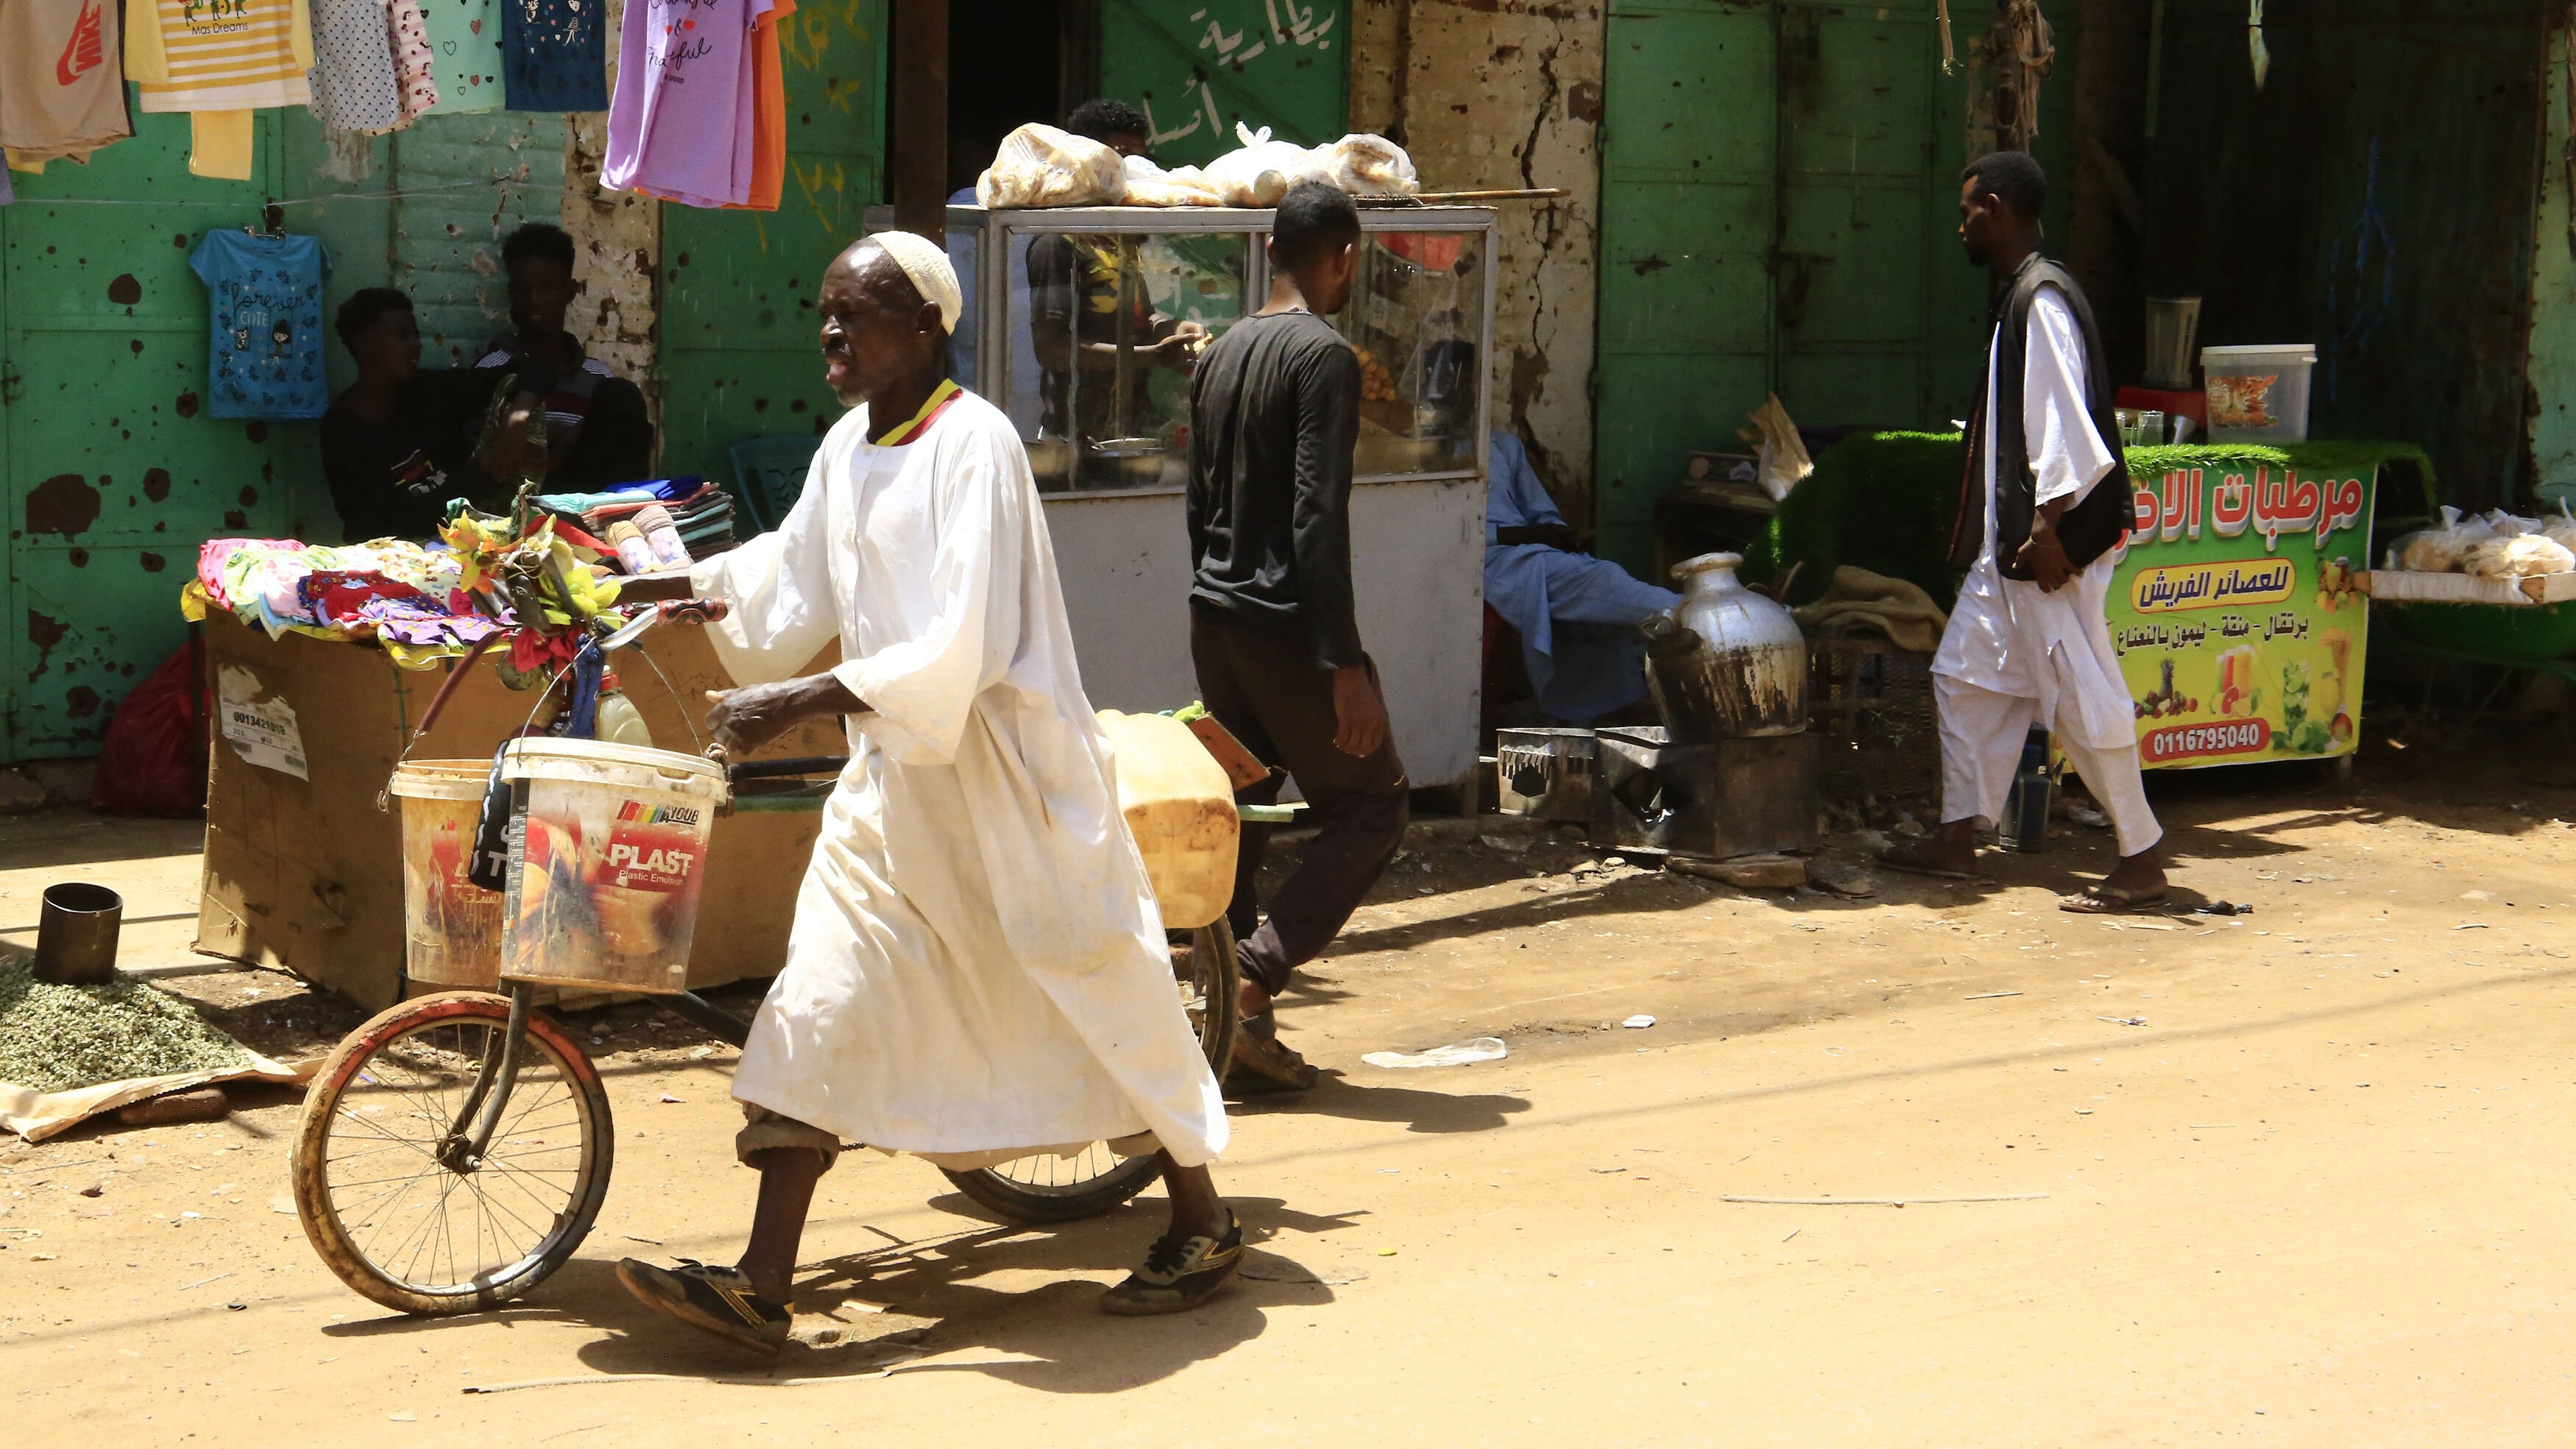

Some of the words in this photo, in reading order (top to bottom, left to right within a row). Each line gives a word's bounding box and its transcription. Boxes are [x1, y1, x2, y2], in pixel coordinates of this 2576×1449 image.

[191, 25, 211, 35] Mas
[212, 21, 249, 33] Dreams
[240, 311, 267, 326] CUTE
[2211, 465, 2363, 551] مرطبات
[2140, 570, 2211, 608] الفريش
[2213, 565, 2289, 600] للعصائر
[2117, 624, 2170, 657] بالنعناع
[2171, 621, 2206, 649] ليمون
[2222, 615, 2249, 637] منقة
[2263, 612, 2309, 642] برتقال
[2153, 723, 2260, 757] 0116795040
[659, 807, 700, 825] AYOUB
[609, 843, 694, 876] PLAST
[619, 869, 648, 881] Plastic
